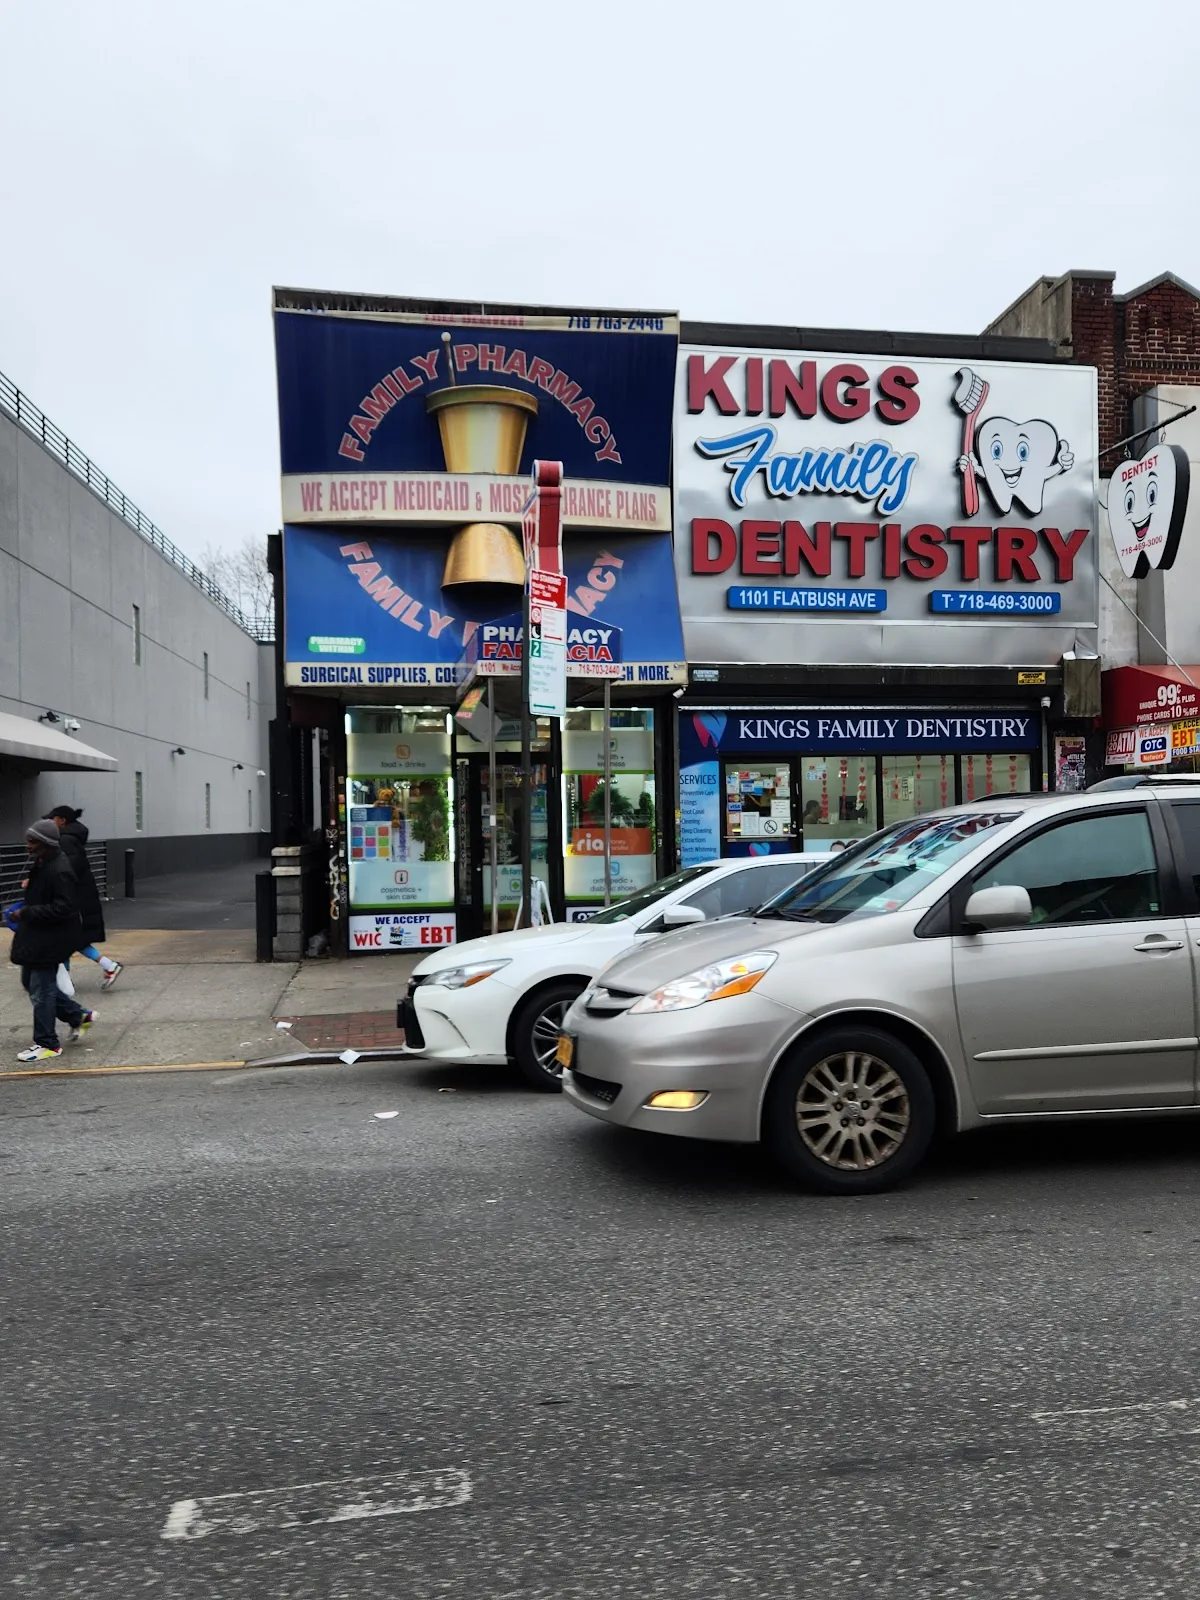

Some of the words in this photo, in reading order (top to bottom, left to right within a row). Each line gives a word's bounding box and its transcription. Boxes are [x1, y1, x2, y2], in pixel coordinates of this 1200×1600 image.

[687, 355, 921, 425] KINGS
[338, 349, 440, 462] FAMILY
[453, 343, 623, 465] PHARMACY
[695, 423, 919, 516] Family
[1121, 454, 1159, 482] DENTIST
[301, 481, 323, 512] WE
[329, 481, 387, 512] ACCEPT
[393, 480, 470, 511] MEDICAID
[475, 491, 482, 511] &
[489, 482, 530, 513] MOST
[616, 490, 657, 521] PLANS
[691, 517, 1090, 583] DENTISTRY
[1121, 535, 1163, 556] 718-469-3000
[340, 541, 455, 640] FAMILY
[739, 590, 769, 606] 1101
[773, 590, 846, 607] FLATBUSH
[850, 593, 876, 609] AVE
[959, 594, 1053, 611] 718-469-3000
[310, 636, 363, 646] PHARMACY
[318, 645, 355, 654] WITHIN
[533, 642, 540, 656] 2
[301, 667, 363, 683] SURGICAL
[368, 667, 431, 685] SUPPLIES,
[480, 663, 496, 673] 1101
[578, 664, 620, 675] 718-703-2440
[638, 665, 674, 681] MORE.
[1139, 700, 1158, 710] UNIQUE
[1181, 694, 1196, 704] PLUS
[1136, 712, 1153, 722] PHONE
[1153, 710, 1171, 721] CARDS
[1170, 705, 1182, 718] 10
[738, 718, 810, 739] KINGS
[816, 719, 899, 739] FAMILY
[905, 718, 1030, 739] DENTISTRY
[1139, 728, 1148, 738] WE
[1116, 731, 1135, 752] ATM
[1144, 739, 1163, 751] OTC
[1172, 728, 1196, 749] EBT
[1143, 753, 1164, 761] Network
[1172, 748, 1188, 756] FOOD
[680, 774, 717, 784] SERVICES
[576, 833, 605, 852] ria
[375, 916, 391, 925] WE
[393, 915, 431, 924] ACCEPT
[353, 932, 382, 946] WIC
[420, 926, 454, 944] EBT
